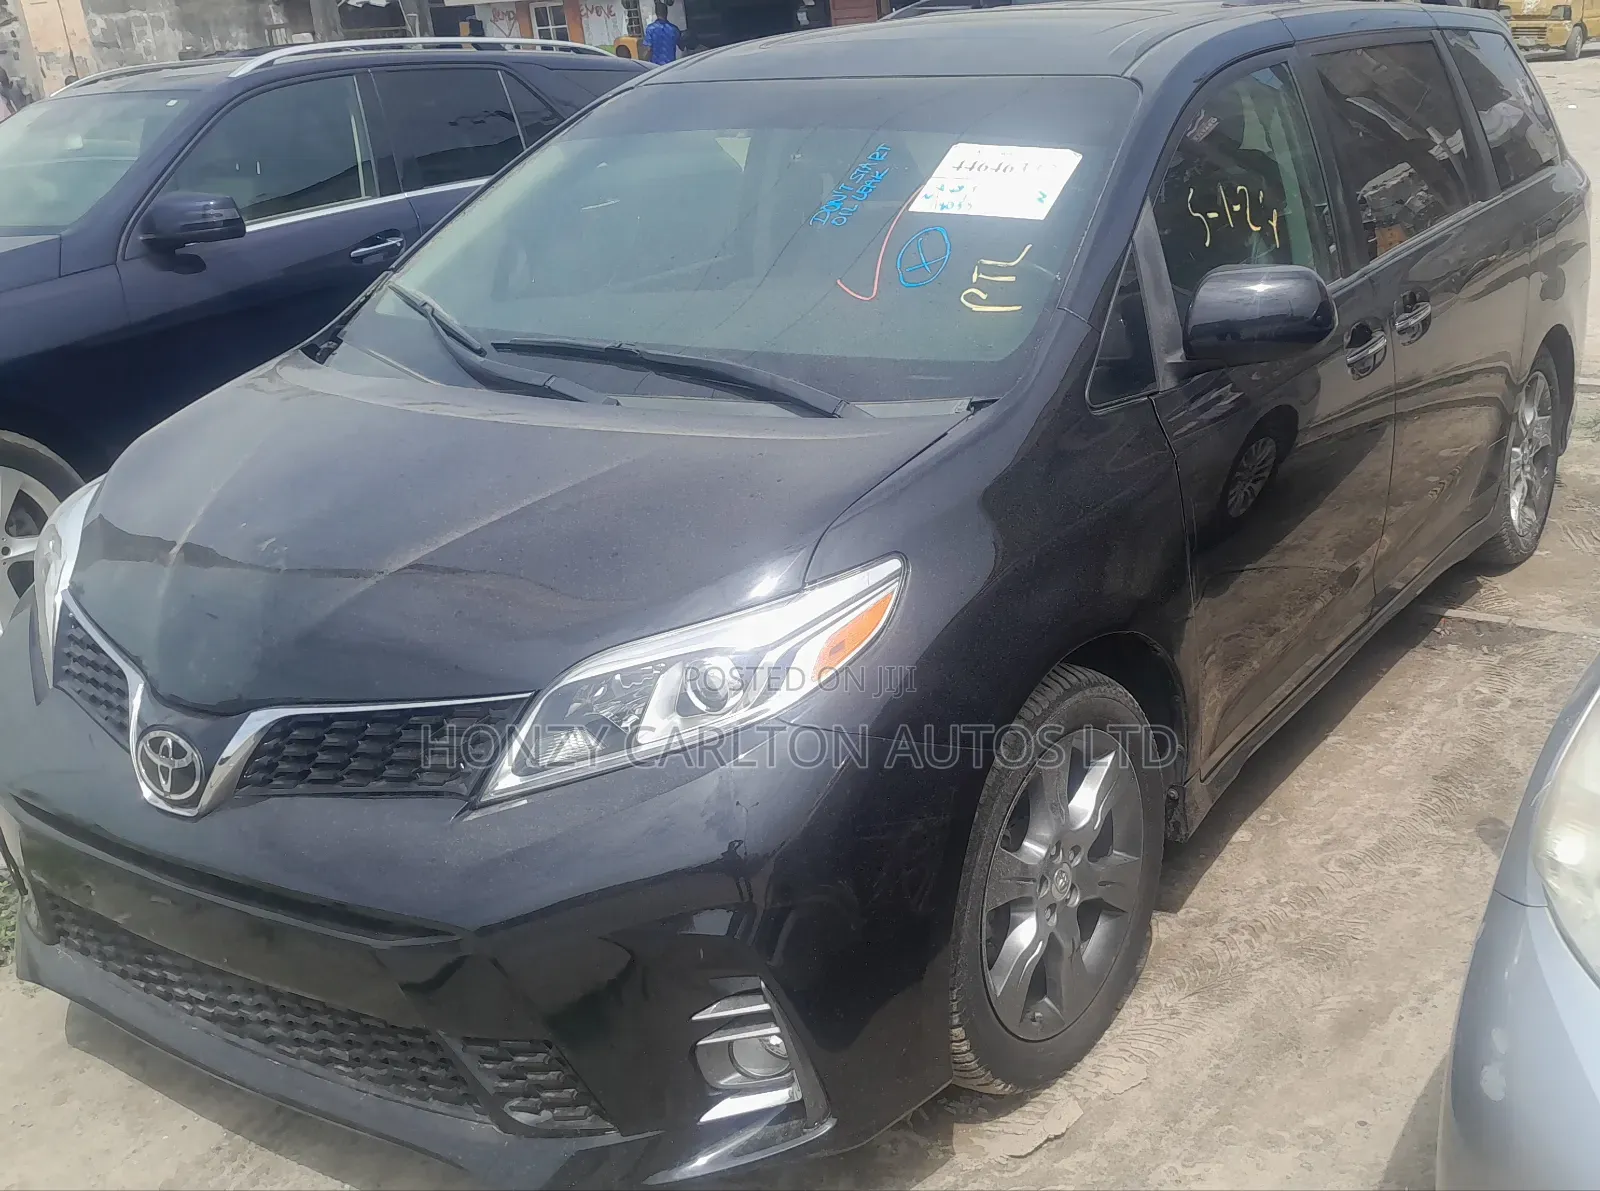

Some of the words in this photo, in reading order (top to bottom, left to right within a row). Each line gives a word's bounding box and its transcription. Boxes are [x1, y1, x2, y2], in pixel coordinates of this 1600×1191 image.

[850, 143, 891, 184] START
[831, 204, 859, 226] OIL
[852, 167, 890, 202] LEAK
